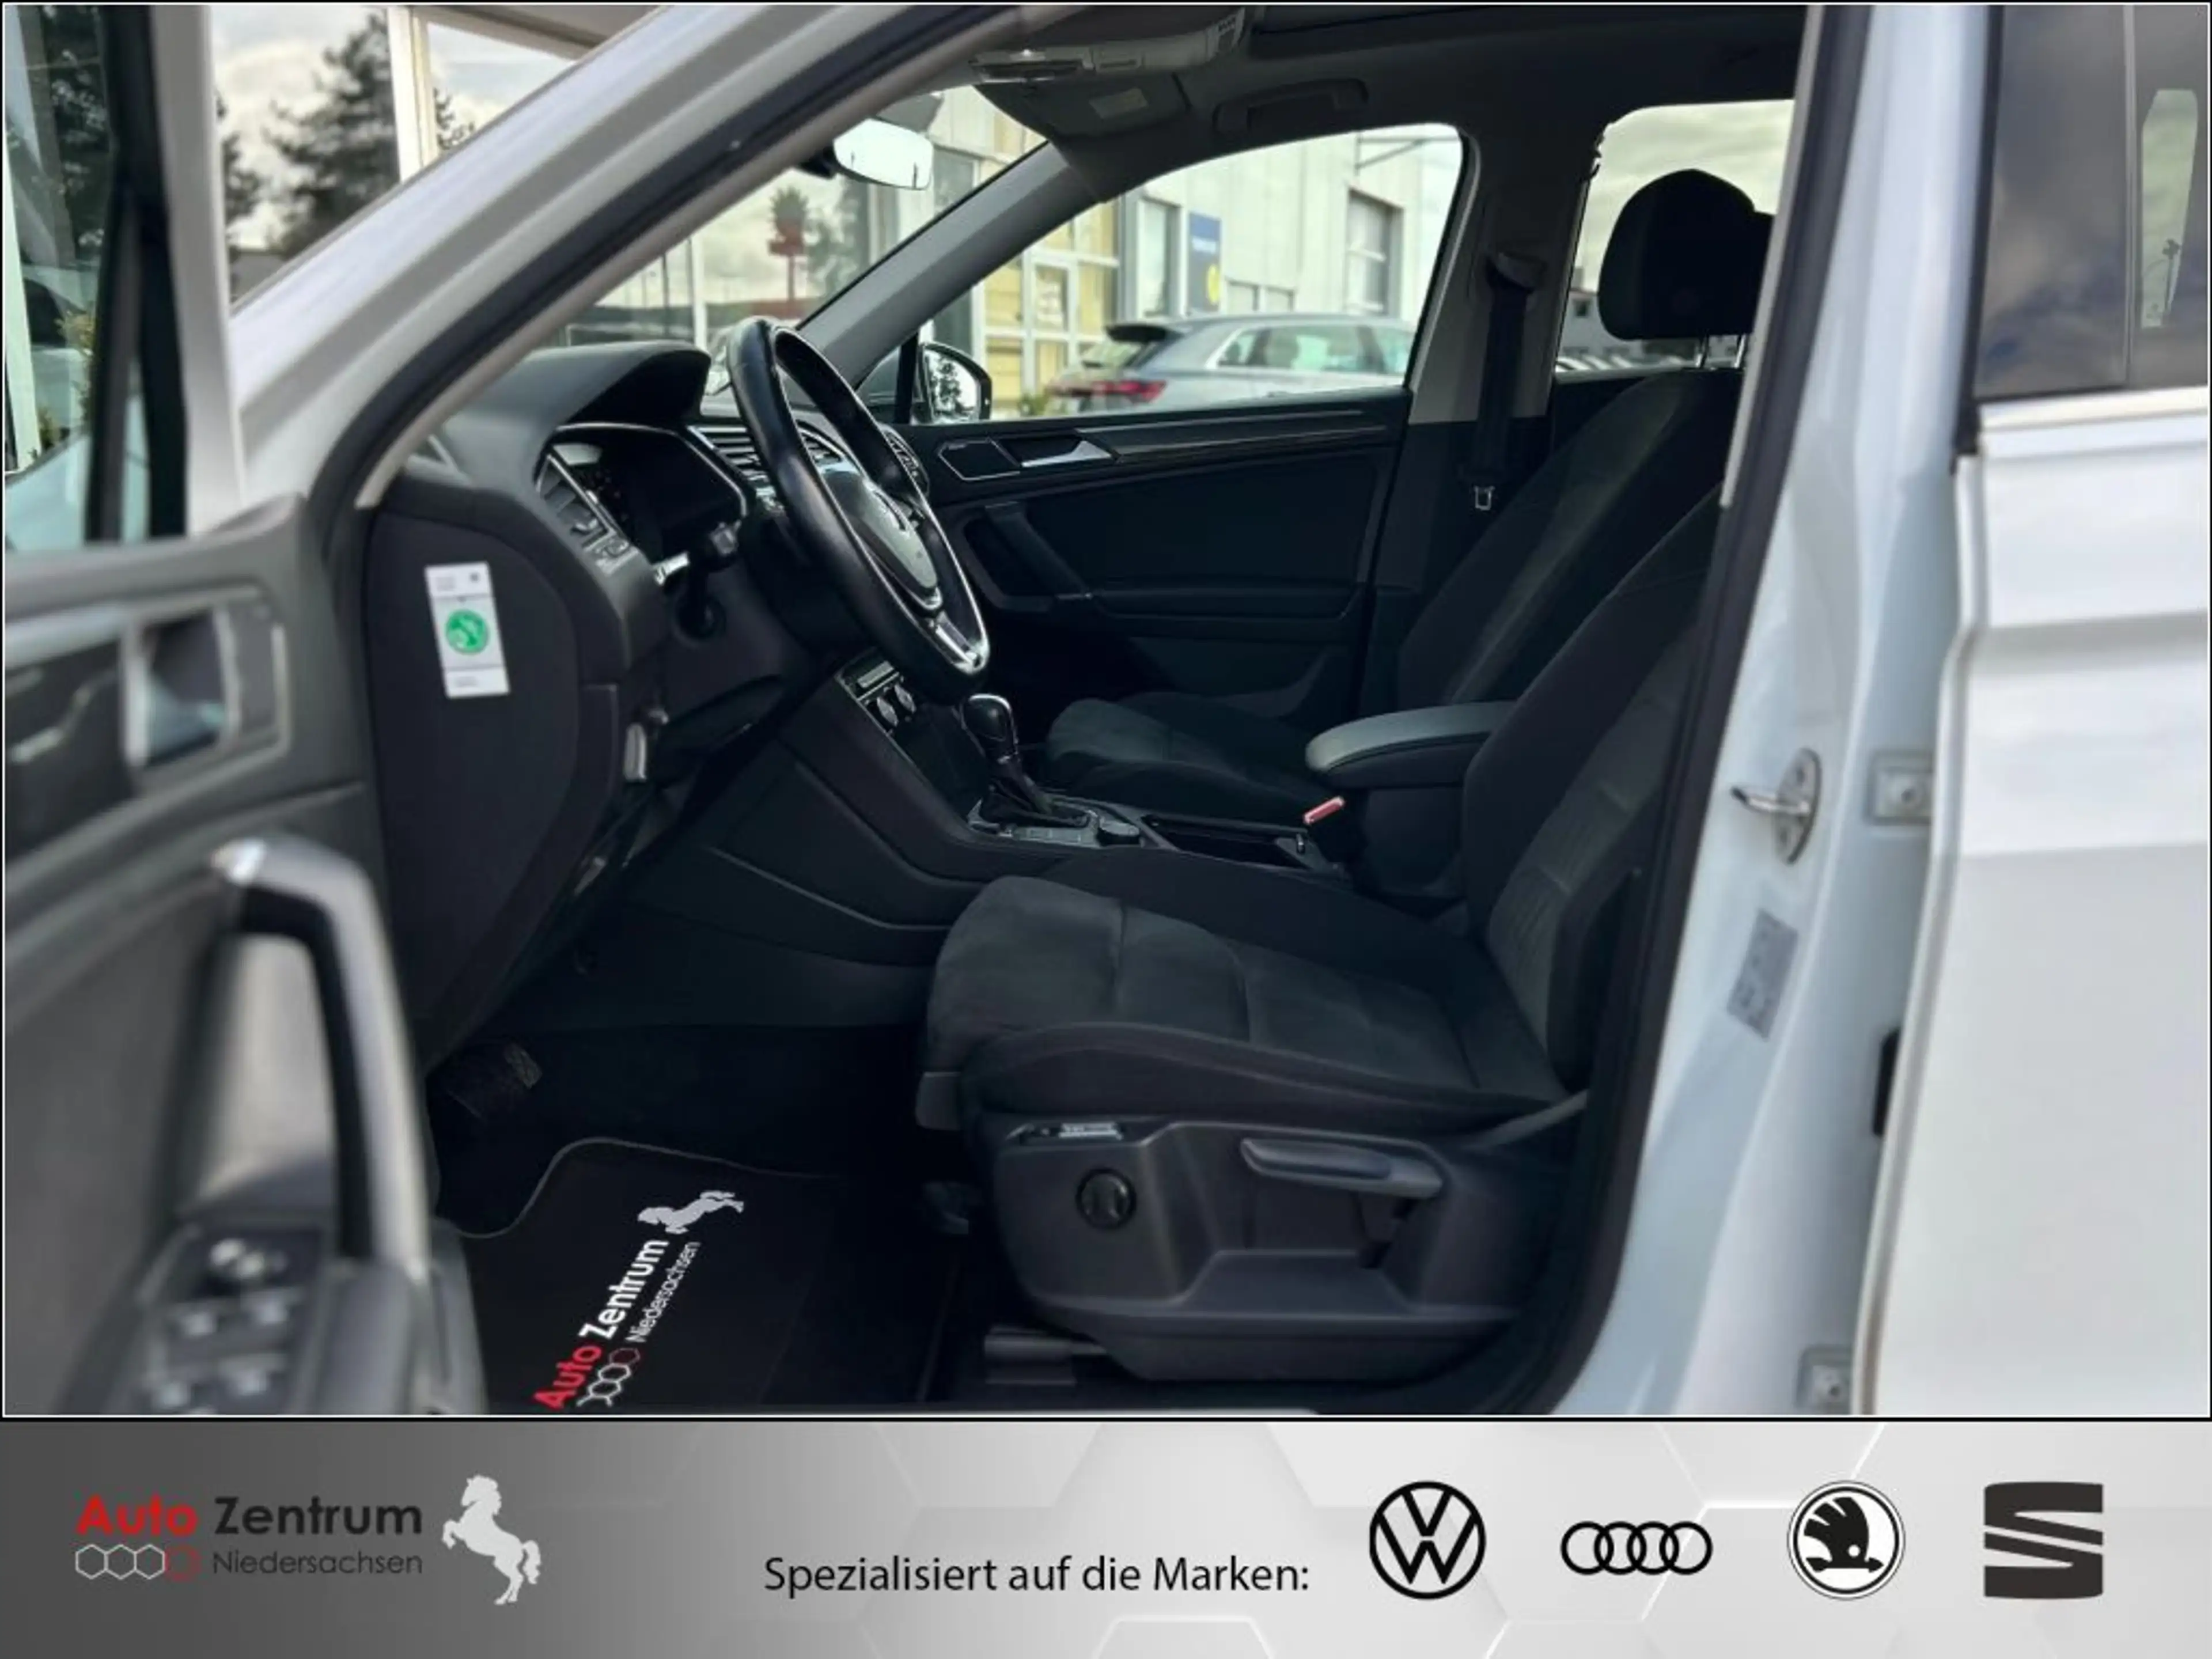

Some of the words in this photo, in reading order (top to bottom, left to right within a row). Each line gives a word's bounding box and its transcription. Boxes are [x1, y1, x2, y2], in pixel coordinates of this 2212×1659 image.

[533, 1345, 602, 1410] Auto
[578, 1239, 670, 1340] Zentrum
[626, 1241, 702, 1343] Niedersachsen
